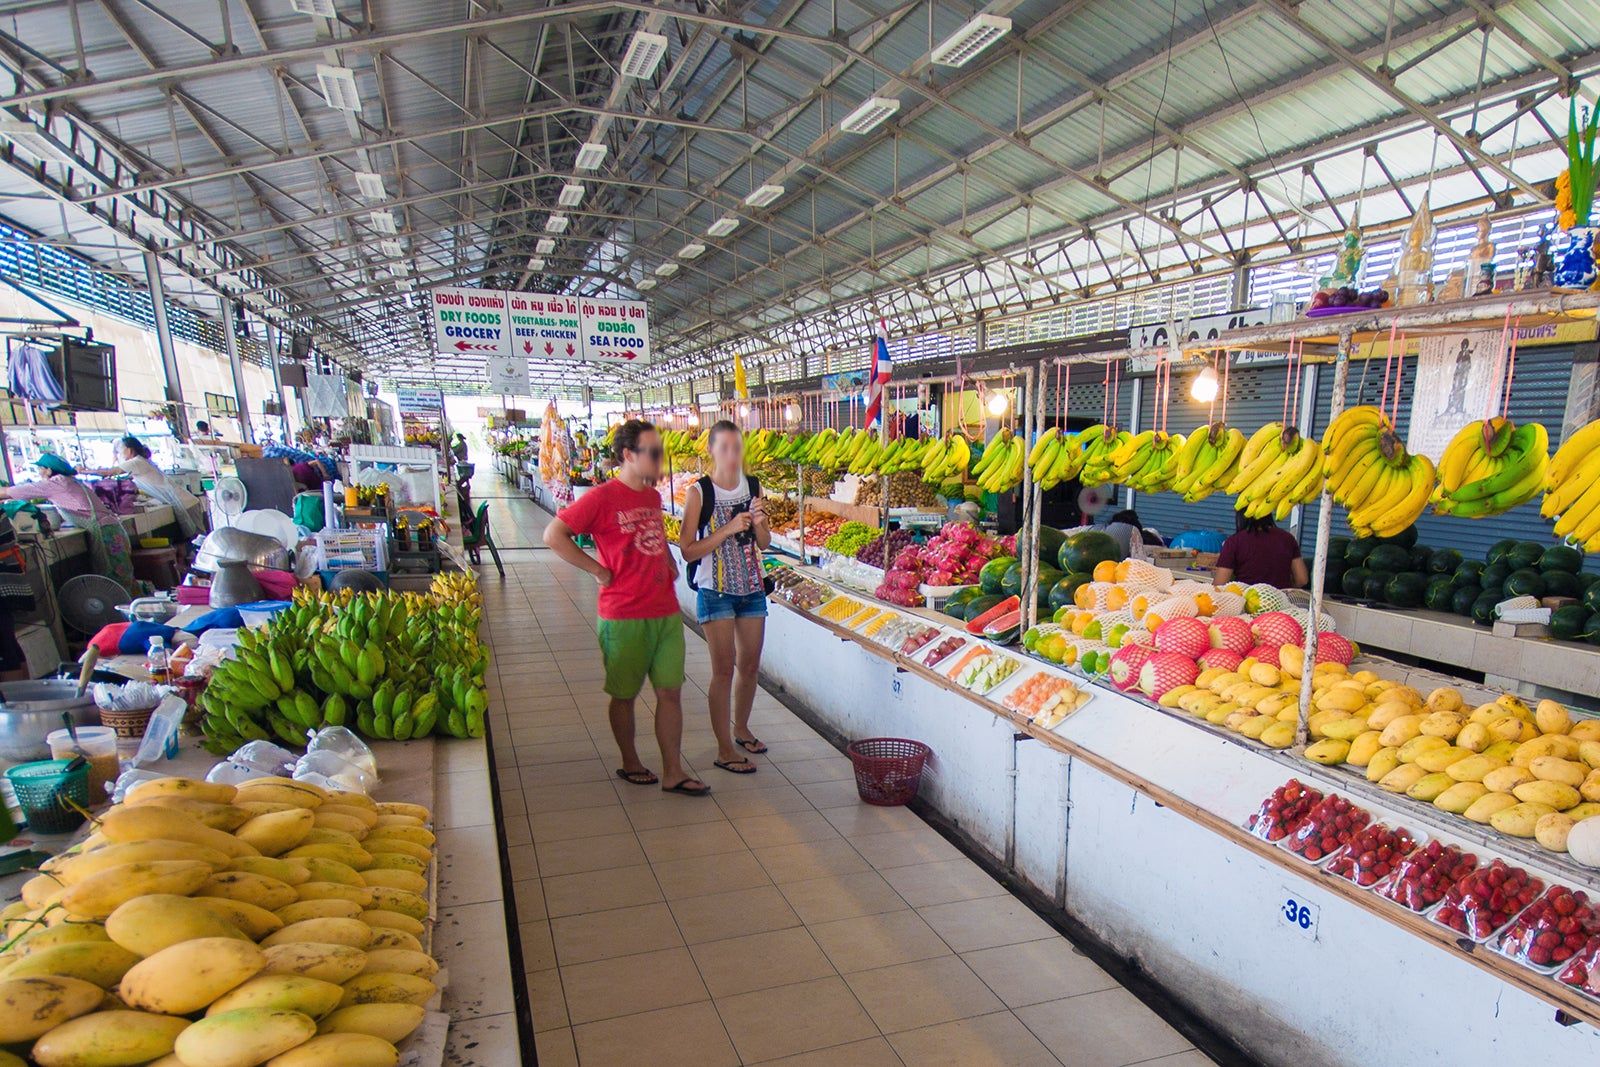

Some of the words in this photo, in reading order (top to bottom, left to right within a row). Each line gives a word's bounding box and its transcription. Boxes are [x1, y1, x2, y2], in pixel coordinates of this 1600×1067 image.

[435, 291, 465, 306] ของชำ
[468, 294, 505, 309] ของแห้ง
[511, 296, 528, 311] ผัก
[530, 301, 544, 316] หมู
[547, 297, 564, 313] เนื้อ
[565, 298, 577, 314] ไก่
[440, 310, 462, 322] DRY
[465, 312, 501, 325] FOODS
[582, 301, 595, 319] กุ้ง
[598, 305, 617, 317] หอย
[619, 305, 626, 321] ปู
[629, 306, 645, 319] ปลา
[559, 319, 579, 329] PORK
[597, 322, 636, 334] ของสด
[445, 326, 501, 340] GROCERY
[515, 327, 538, 337] BEEF,
[540, 329, 577, 339] CHICKEN
[589, 335, 610, 347] SEA
[613, 337, 644, 348] FOOD
[1285, 898, 1311, 930] 36
